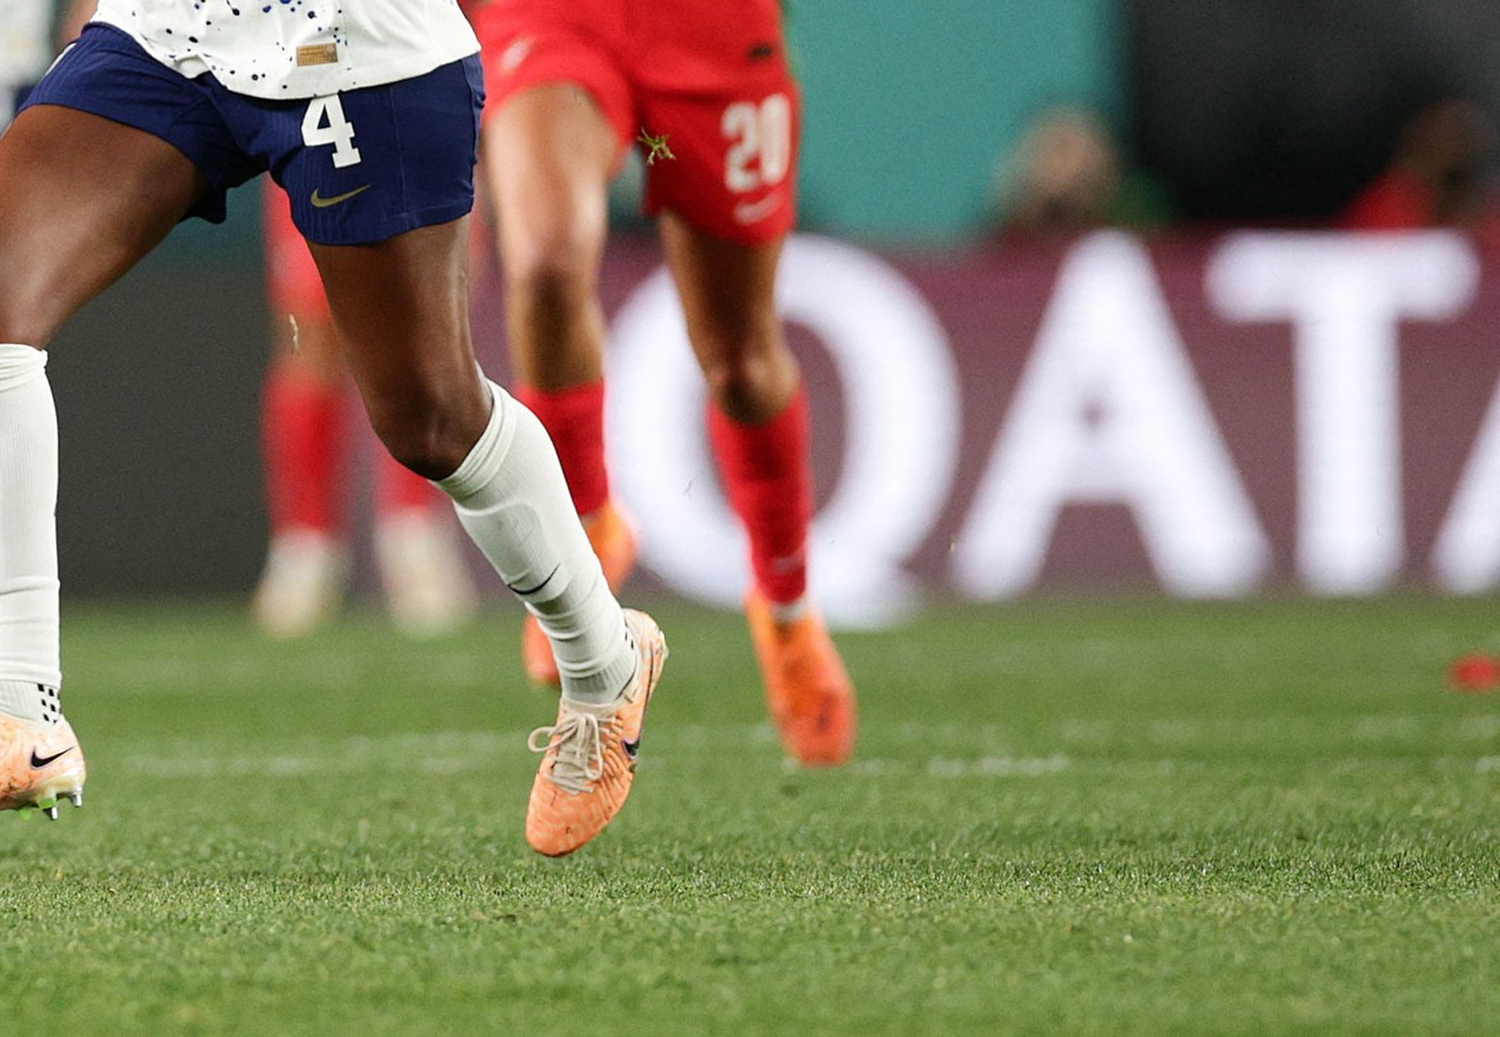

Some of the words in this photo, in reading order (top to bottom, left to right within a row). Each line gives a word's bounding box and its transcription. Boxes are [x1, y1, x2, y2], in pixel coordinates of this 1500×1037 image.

[301, 93, 361, 169] 4
[721, 94, 791, 192] 20
[606, 228, 1500, 631] QAT
